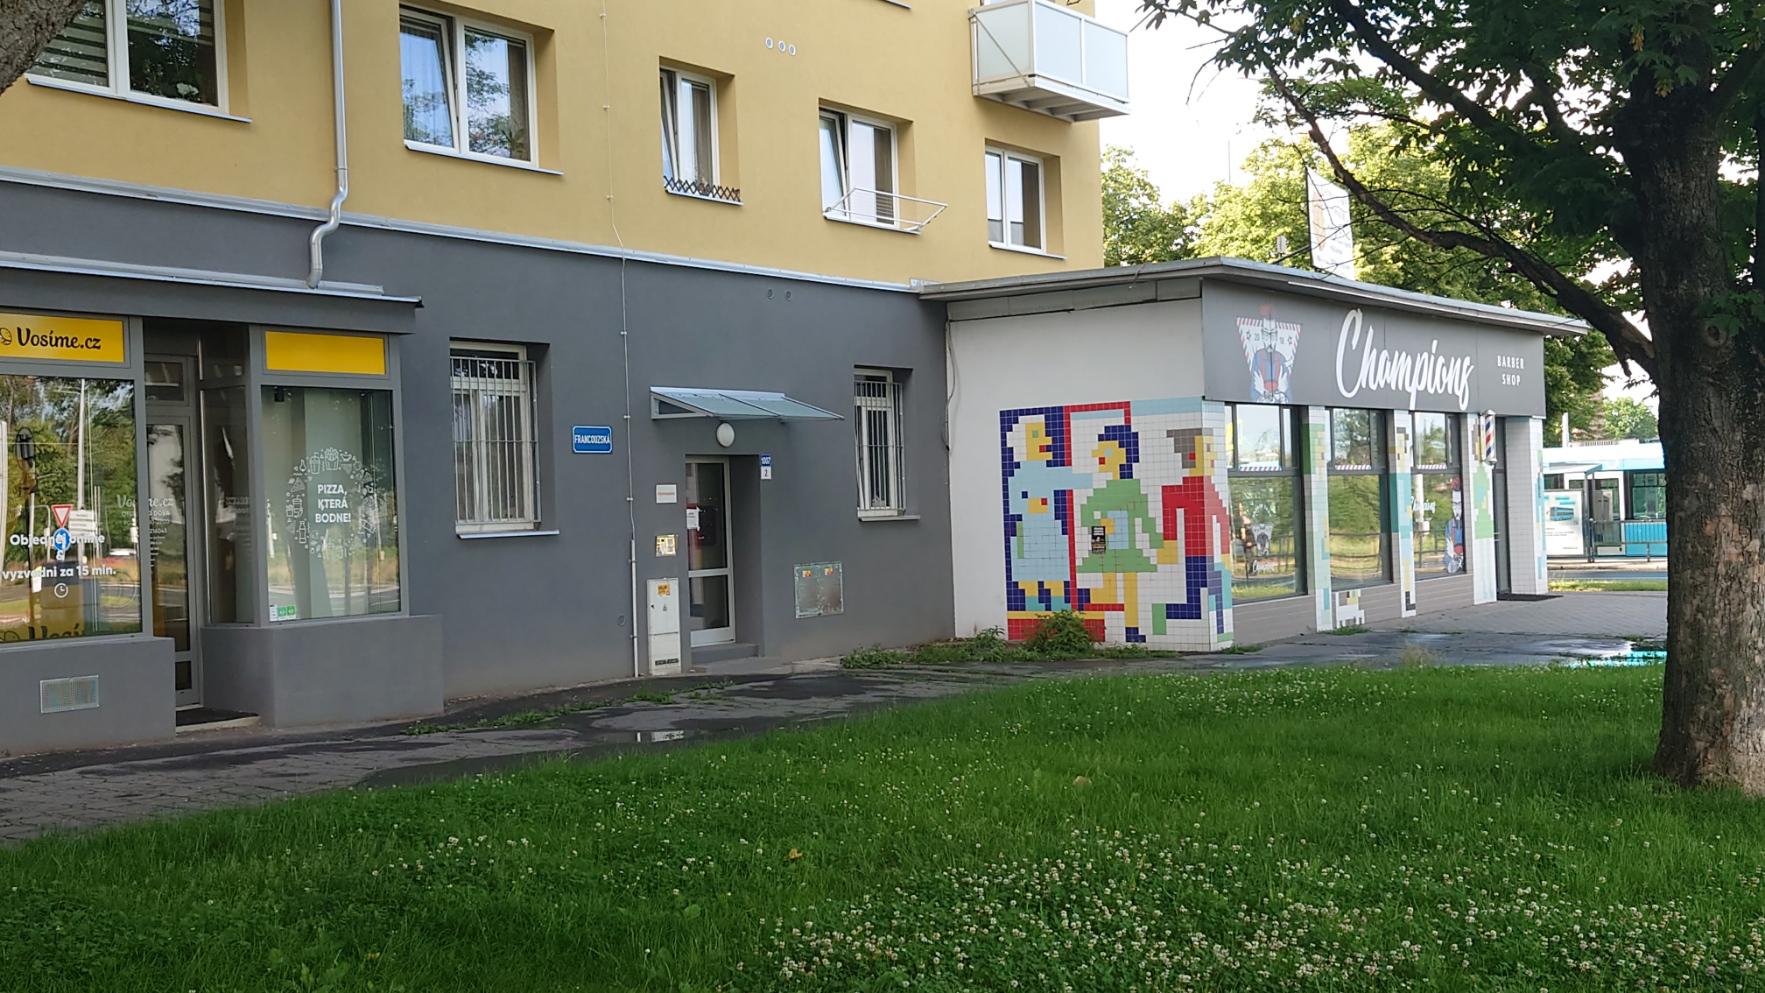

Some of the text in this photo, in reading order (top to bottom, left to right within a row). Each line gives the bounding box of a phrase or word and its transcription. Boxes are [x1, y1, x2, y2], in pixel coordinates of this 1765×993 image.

[16, 327, 101, 350] Vosíme.cz
[1336, 308, 1475, 411] Champions
[1497, 355, 1525, 370] BARBER
[1501, 373, 1521, 386] SHOP
[317, 484, 348, 496] PIZZA,
[315, 512, 352, 523] BODNE!
[60, 568, 73, 577] za
[76, 565, 89, 576] 15
[91, 565, 117, 577] min.
